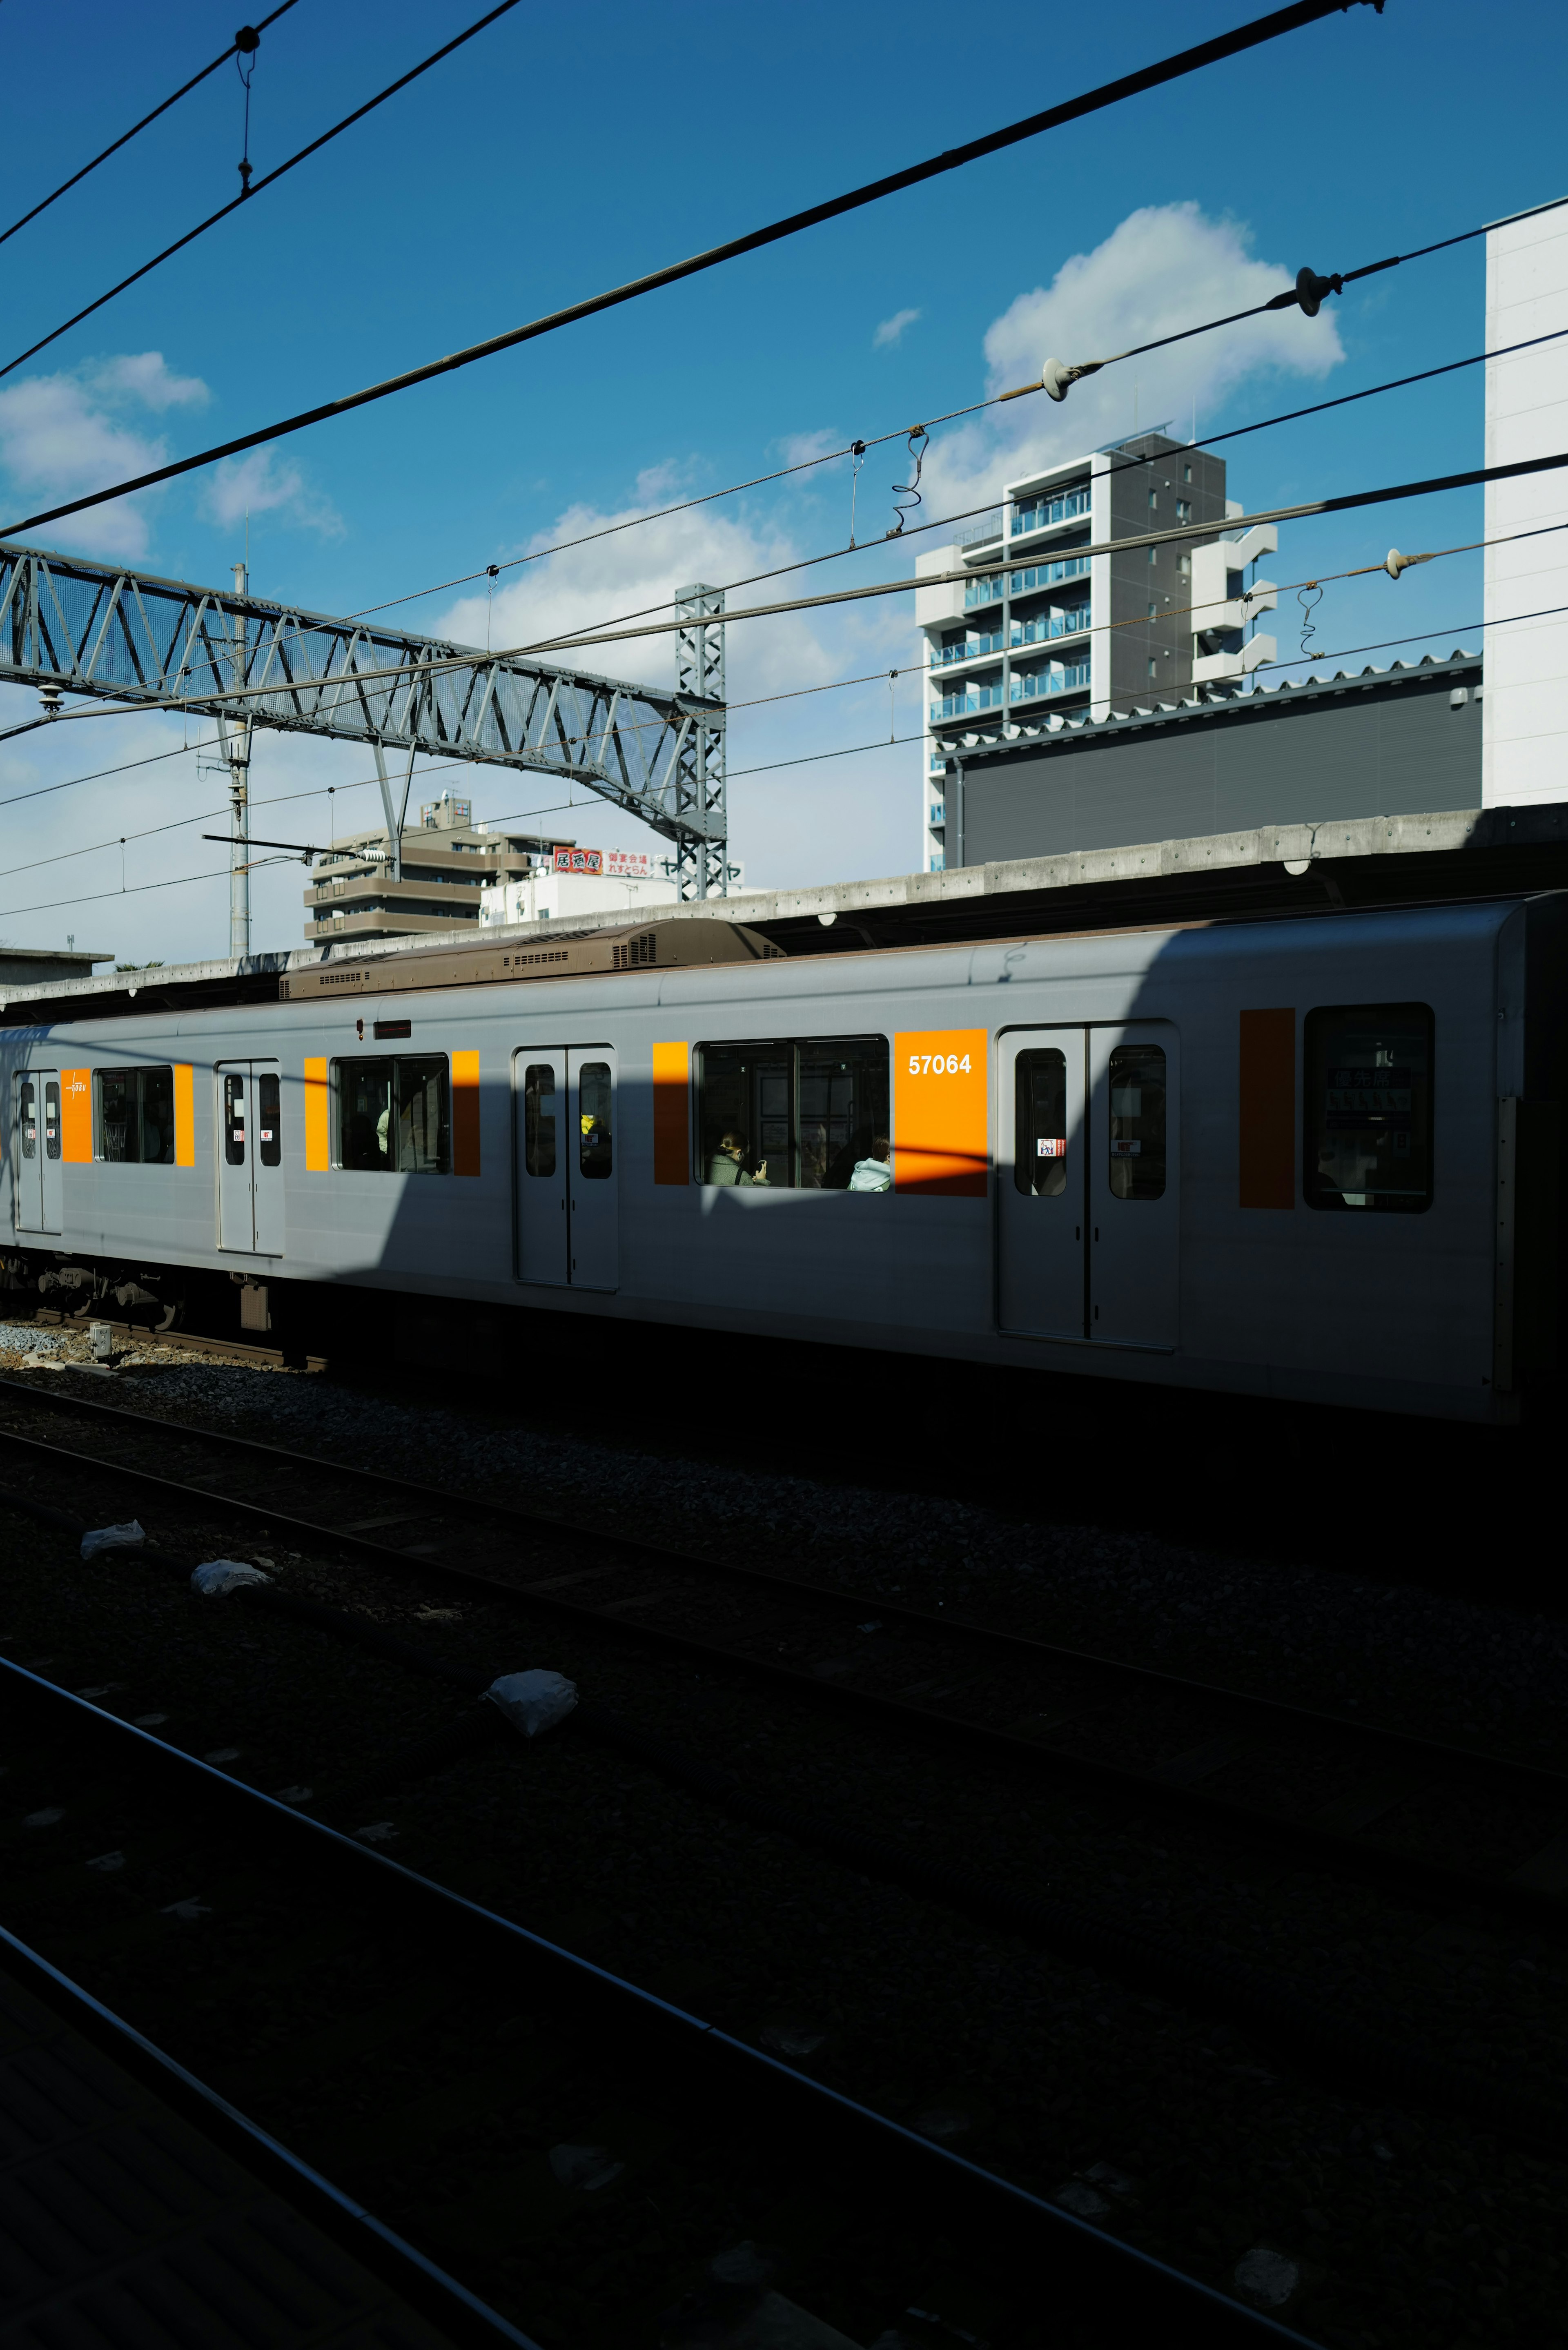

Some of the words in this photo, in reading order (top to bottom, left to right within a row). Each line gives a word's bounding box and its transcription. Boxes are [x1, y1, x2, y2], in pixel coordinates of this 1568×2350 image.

[557, 852, 601, 870] 居酒屋
[608, 852, 647, 864] 御宴会場
[608, 864, 647, 875] れすとらん
[909, 1054, 971, 1075] 57064
[1334, 1069, 1390, 1087] 優先席
